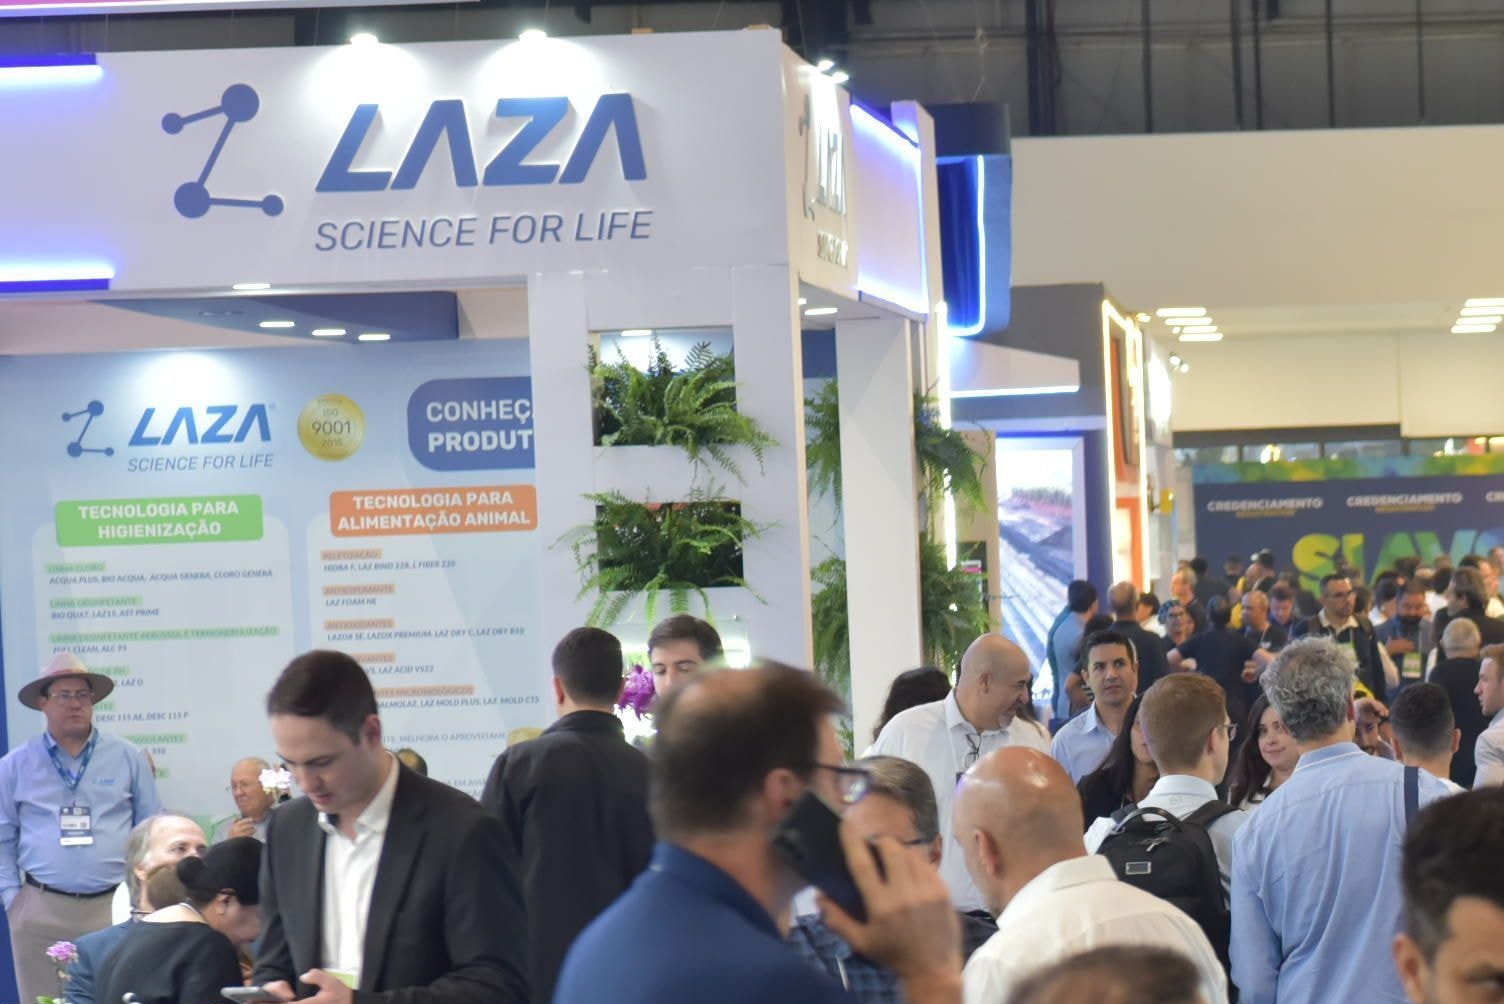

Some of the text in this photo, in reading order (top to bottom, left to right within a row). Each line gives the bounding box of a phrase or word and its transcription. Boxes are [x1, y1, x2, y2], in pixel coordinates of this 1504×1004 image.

[315, 93, 647, 192] LAZA
[315, 211, 653, 251] SCIENCE FOR LIFE
[323, 407, 339, 417] ISO
[426, 398, 534, 425] CONHEÇ
[128, 404, 272, 447] LAZA
[311, 420, 351, 436] 9001
[428, 429, 533, 453] PRODUT
[127, 453, 275, 473] SCIENCE FOR LIFE
[78, 500, 239, 520] TECNOLOGIA PARA
[353, 491, 513, 510] TECNOLOGIA PARA
[1207, 497, 1323, 512] CREDENCIAMENTO
[98, 520, 221, 540] HIGIENIZAÇÃO
[337, 511, 530, 531] ALIMENTAÇÃO ANIMAL
[49, 575, 78, 585] ACQUA
[150, 572, 178, 582] ACQUA
[325, 598, 341, 607] LAZ
[378, 666, 393, 674] LAZ
[394, 665, 413, 674] ACID
[420, 699, 434, 708] LAZ
[435, 698, 459, 708] MOLD
[483, 697, 497, 706] LAZ
[500, 696, 524, 705] MOLD
[449, 731, 506, 741] APROVEITAME
